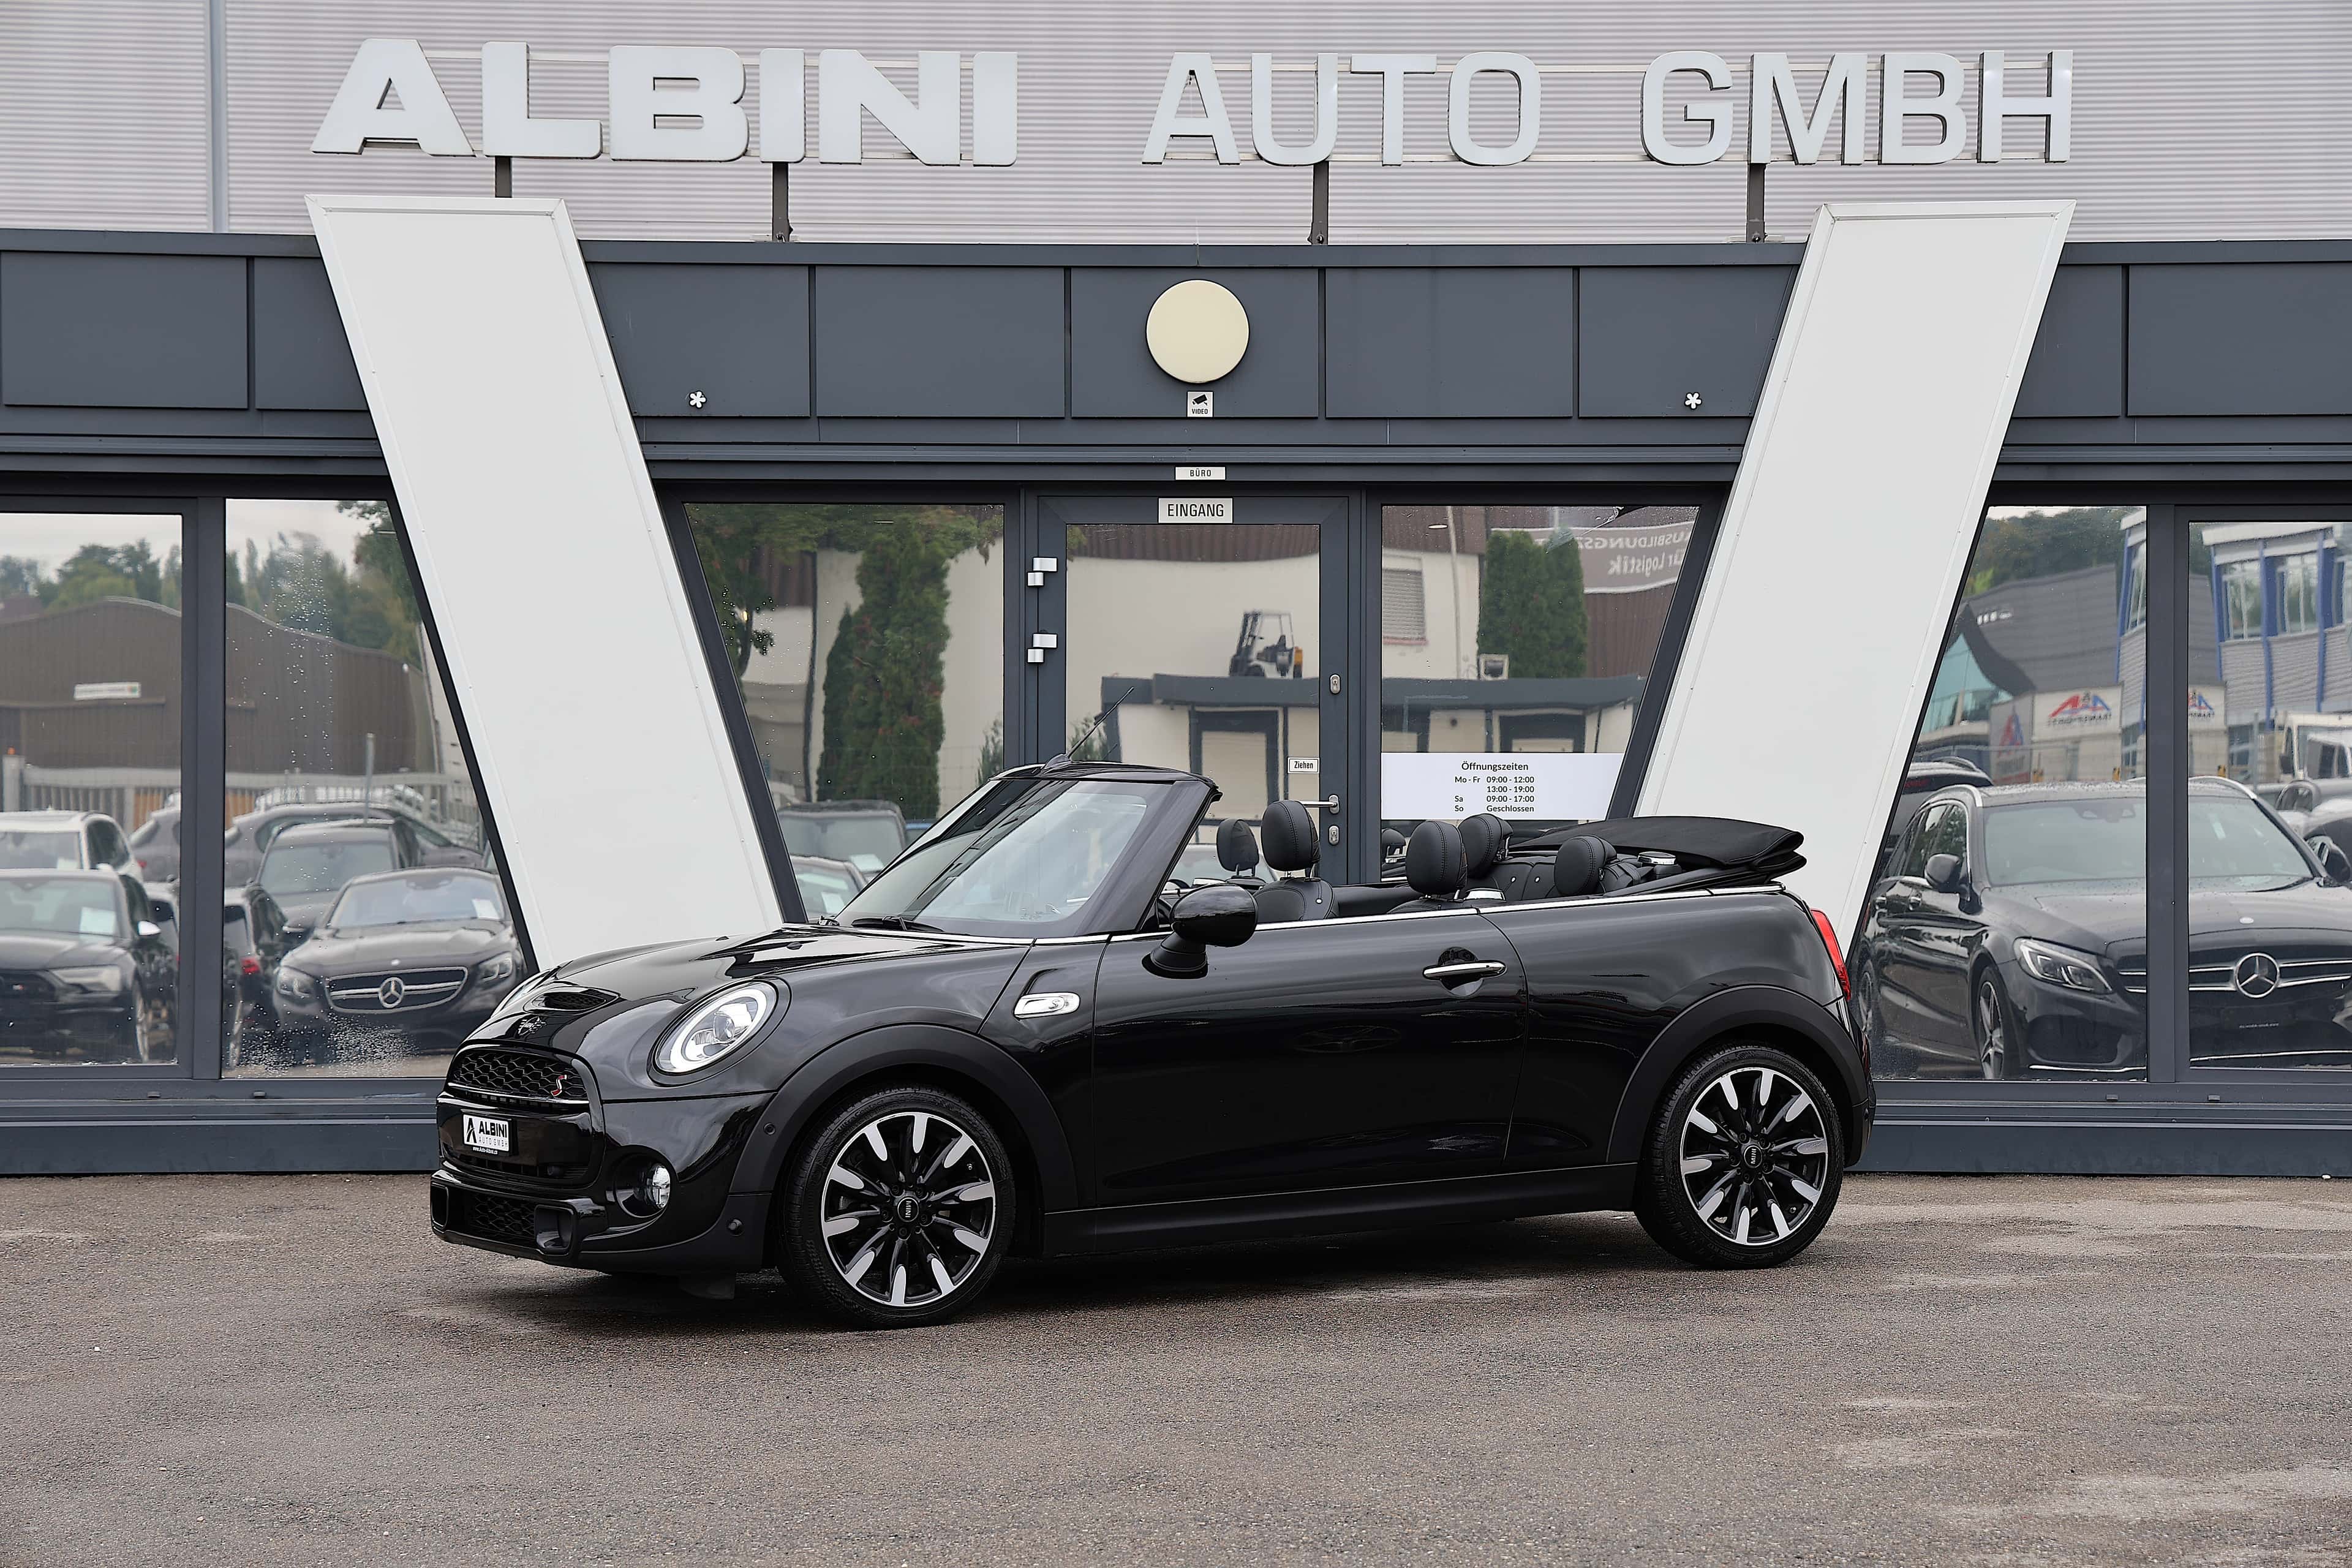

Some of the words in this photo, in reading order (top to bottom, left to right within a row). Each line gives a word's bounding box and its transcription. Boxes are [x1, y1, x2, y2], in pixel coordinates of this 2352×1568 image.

[311, 38, 1018, 167] ALBINI
[1141, 51, 1542, 167] AUTO
[1640, 50, 2073, 167] GMBH
[1190, 468, 1212, 477] BÜRO
[1167, 503, 1224, 517] EINGANG
[1294, 761, 1313, 769] Ziehen
[1461, 761, 1529, 772] Öffnungszeiten
[478, 1120, 508, 1138] ALBINI
[478, 1136, 492, 1145] AUTO
